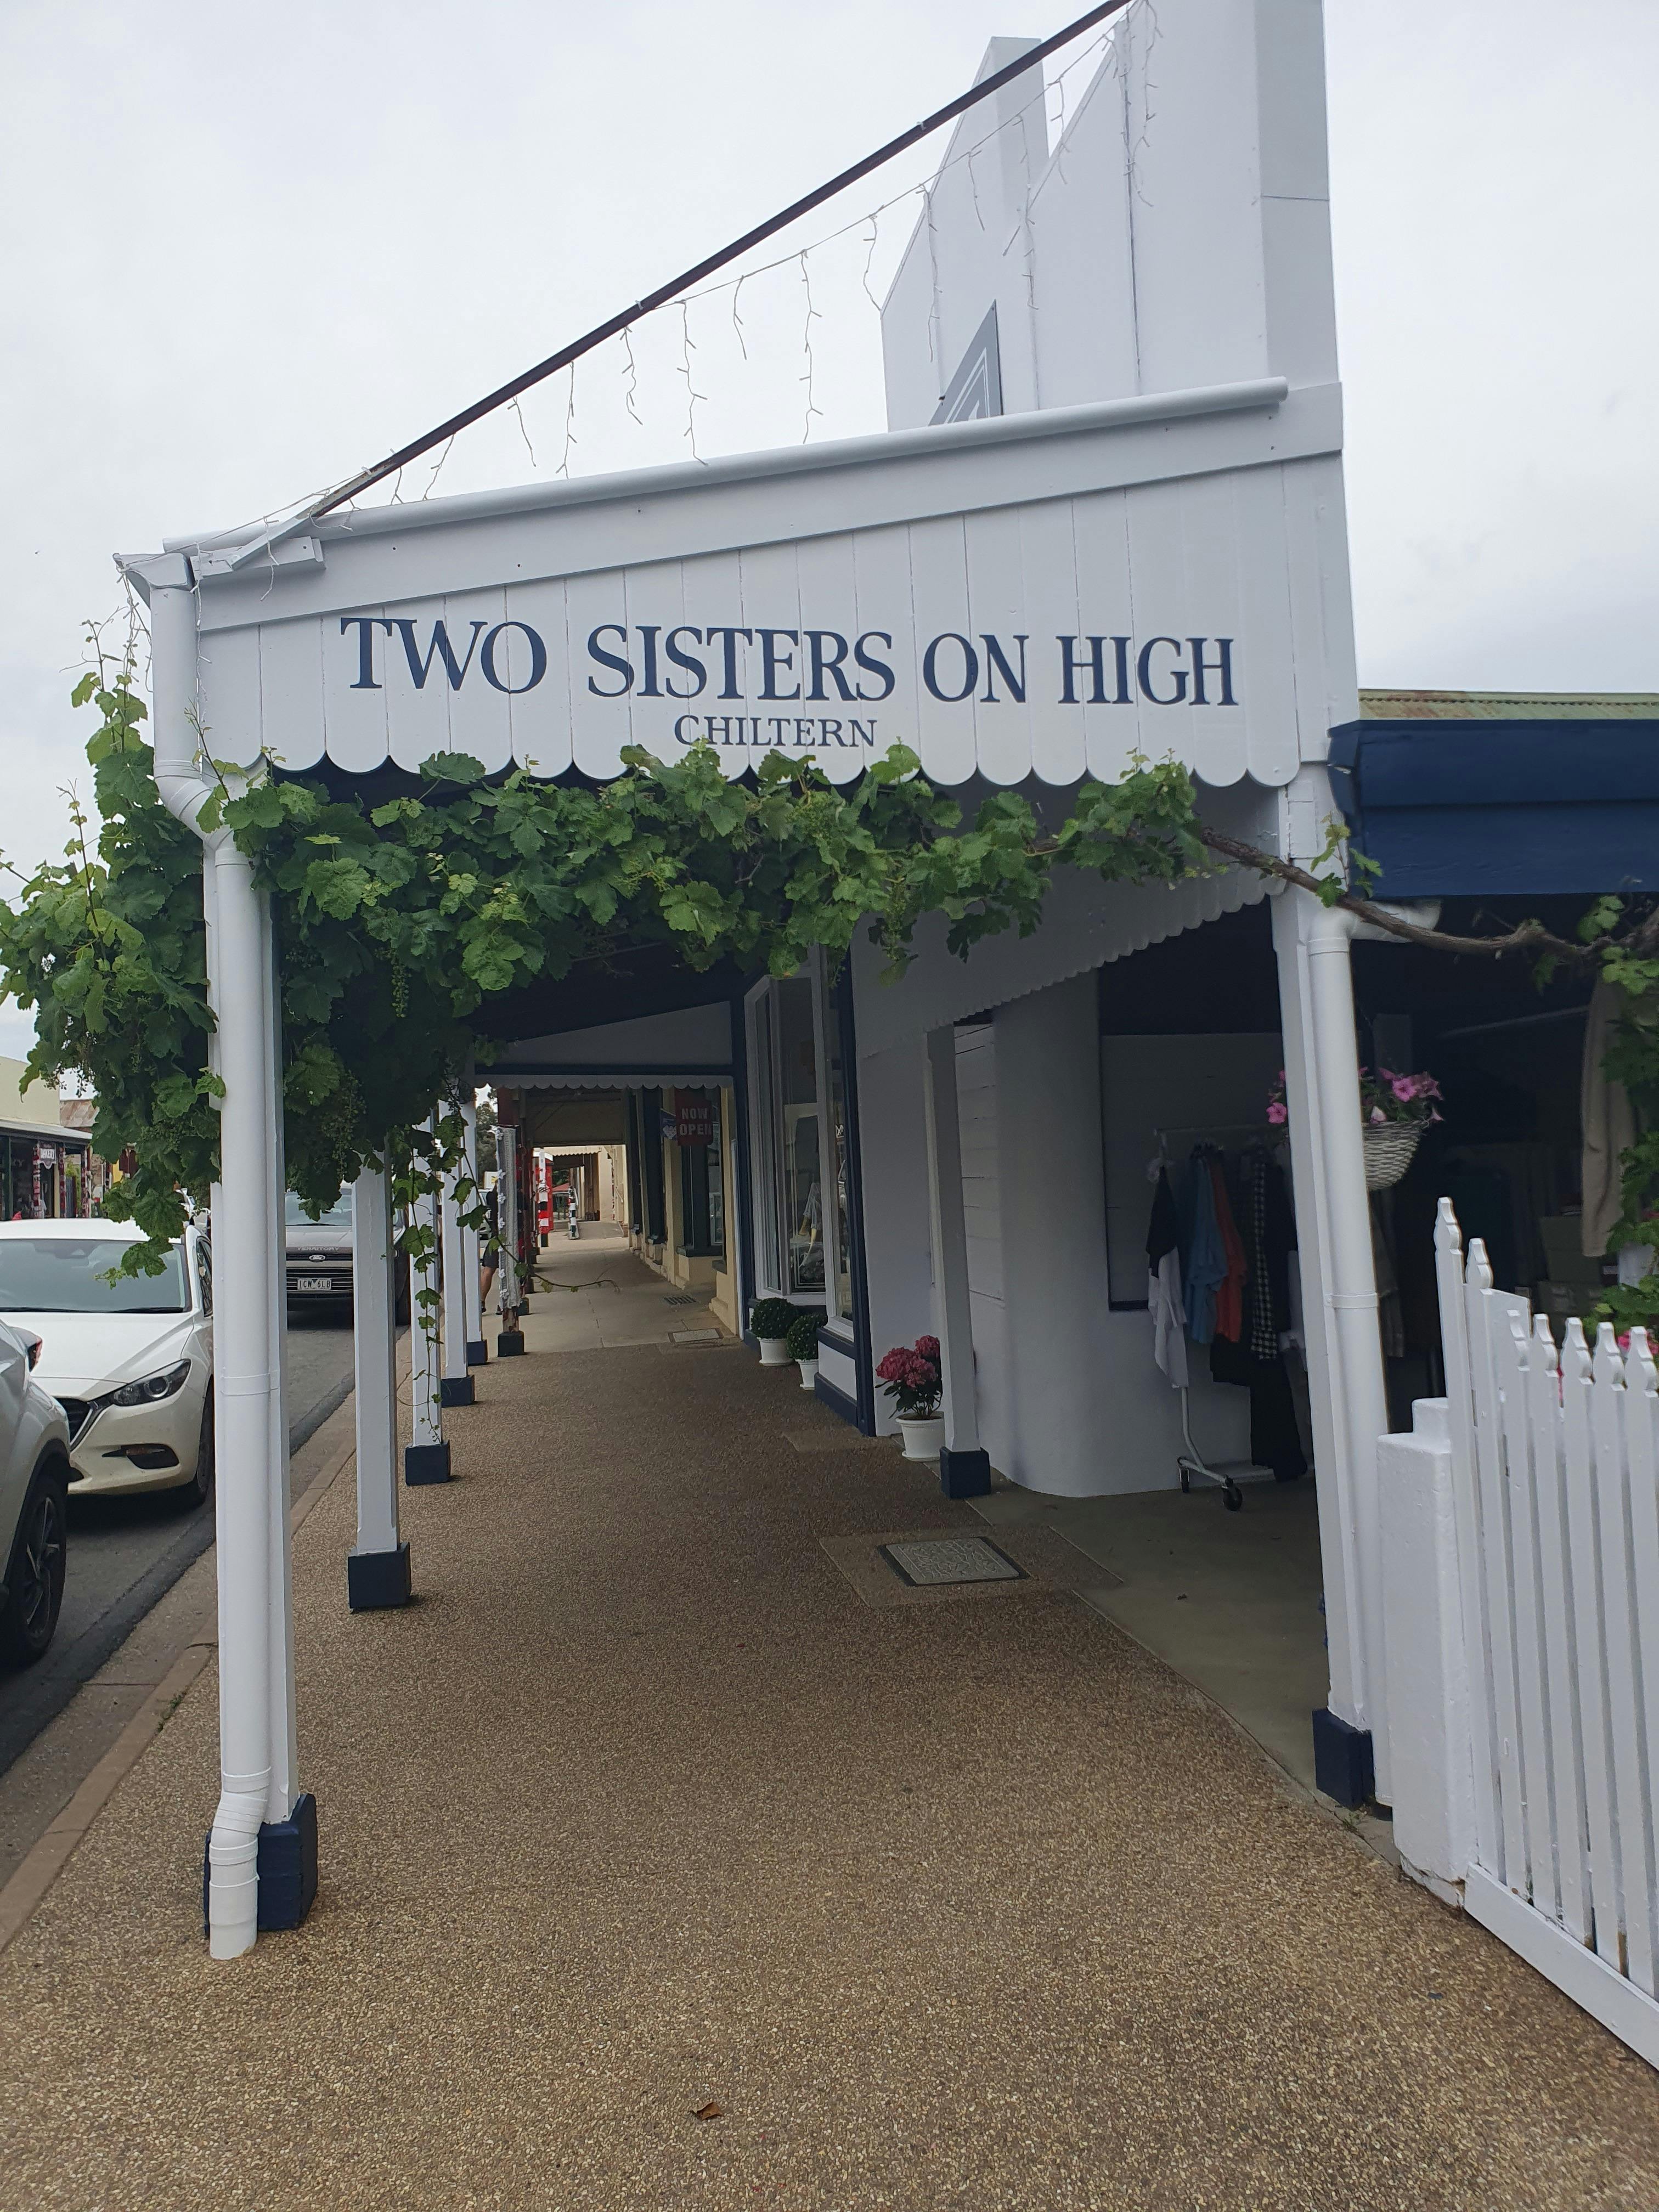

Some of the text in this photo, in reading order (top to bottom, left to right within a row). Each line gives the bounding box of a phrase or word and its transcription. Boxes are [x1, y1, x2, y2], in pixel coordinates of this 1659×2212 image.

[340, 617, 1239, 706] TWO SISTERS ON HIGH
[674, 714, 878, 747] CHILTERN
[681, 1108, 708, 1120] NOW
[680, 1124, 712, 1136] OPEN
